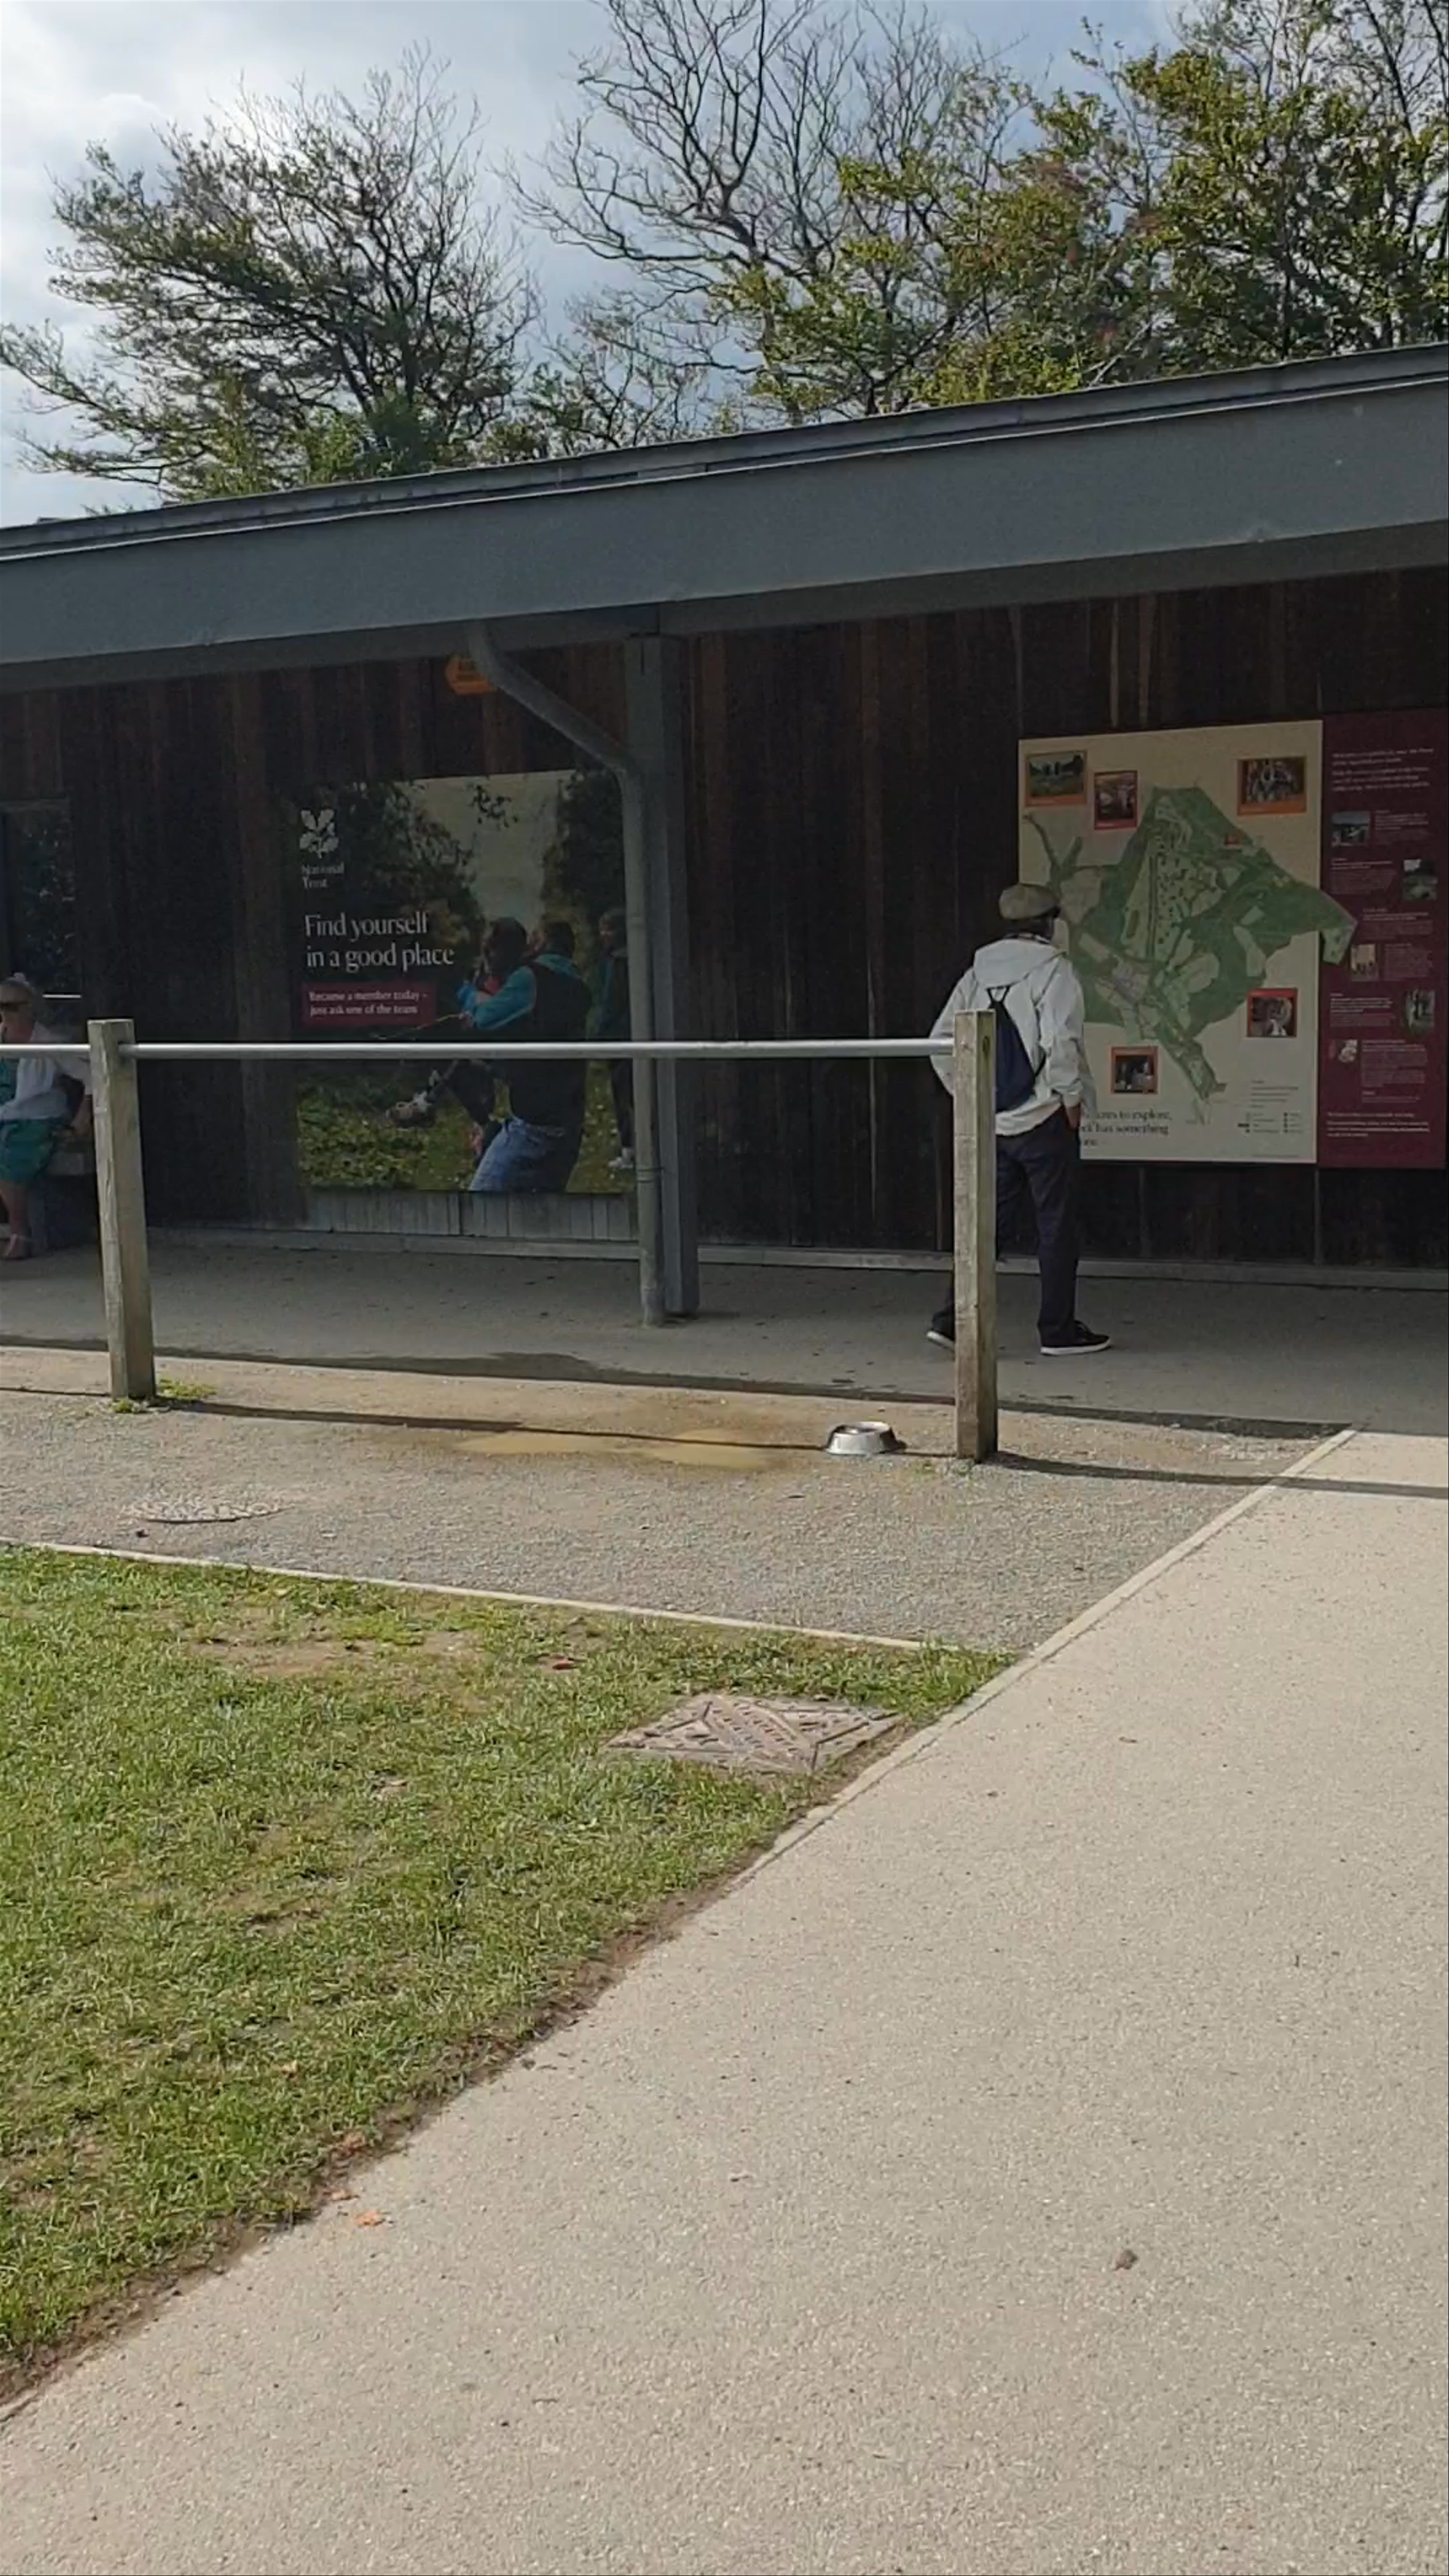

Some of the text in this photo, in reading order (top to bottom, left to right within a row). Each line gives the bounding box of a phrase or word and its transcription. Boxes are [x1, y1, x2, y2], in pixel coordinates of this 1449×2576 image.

[301, 862, 344, 875] National
[302, 877, 327, 889] Trust
[305, 912, 429, 943] Find yourself
[307, 942, 454, 973] in a good place
[309, 992, 345, 1001] Become
[354, 990, 392, 1000] member
[394, 990, 420, 1001] today
[311, 1005, 327, 1017] just
[329, 1005, 344, 1014] ask
[364, 1004, 375, 1014] of
[377, 1004, 392, 1014] the
[394, 1005, 418, 1014] team
